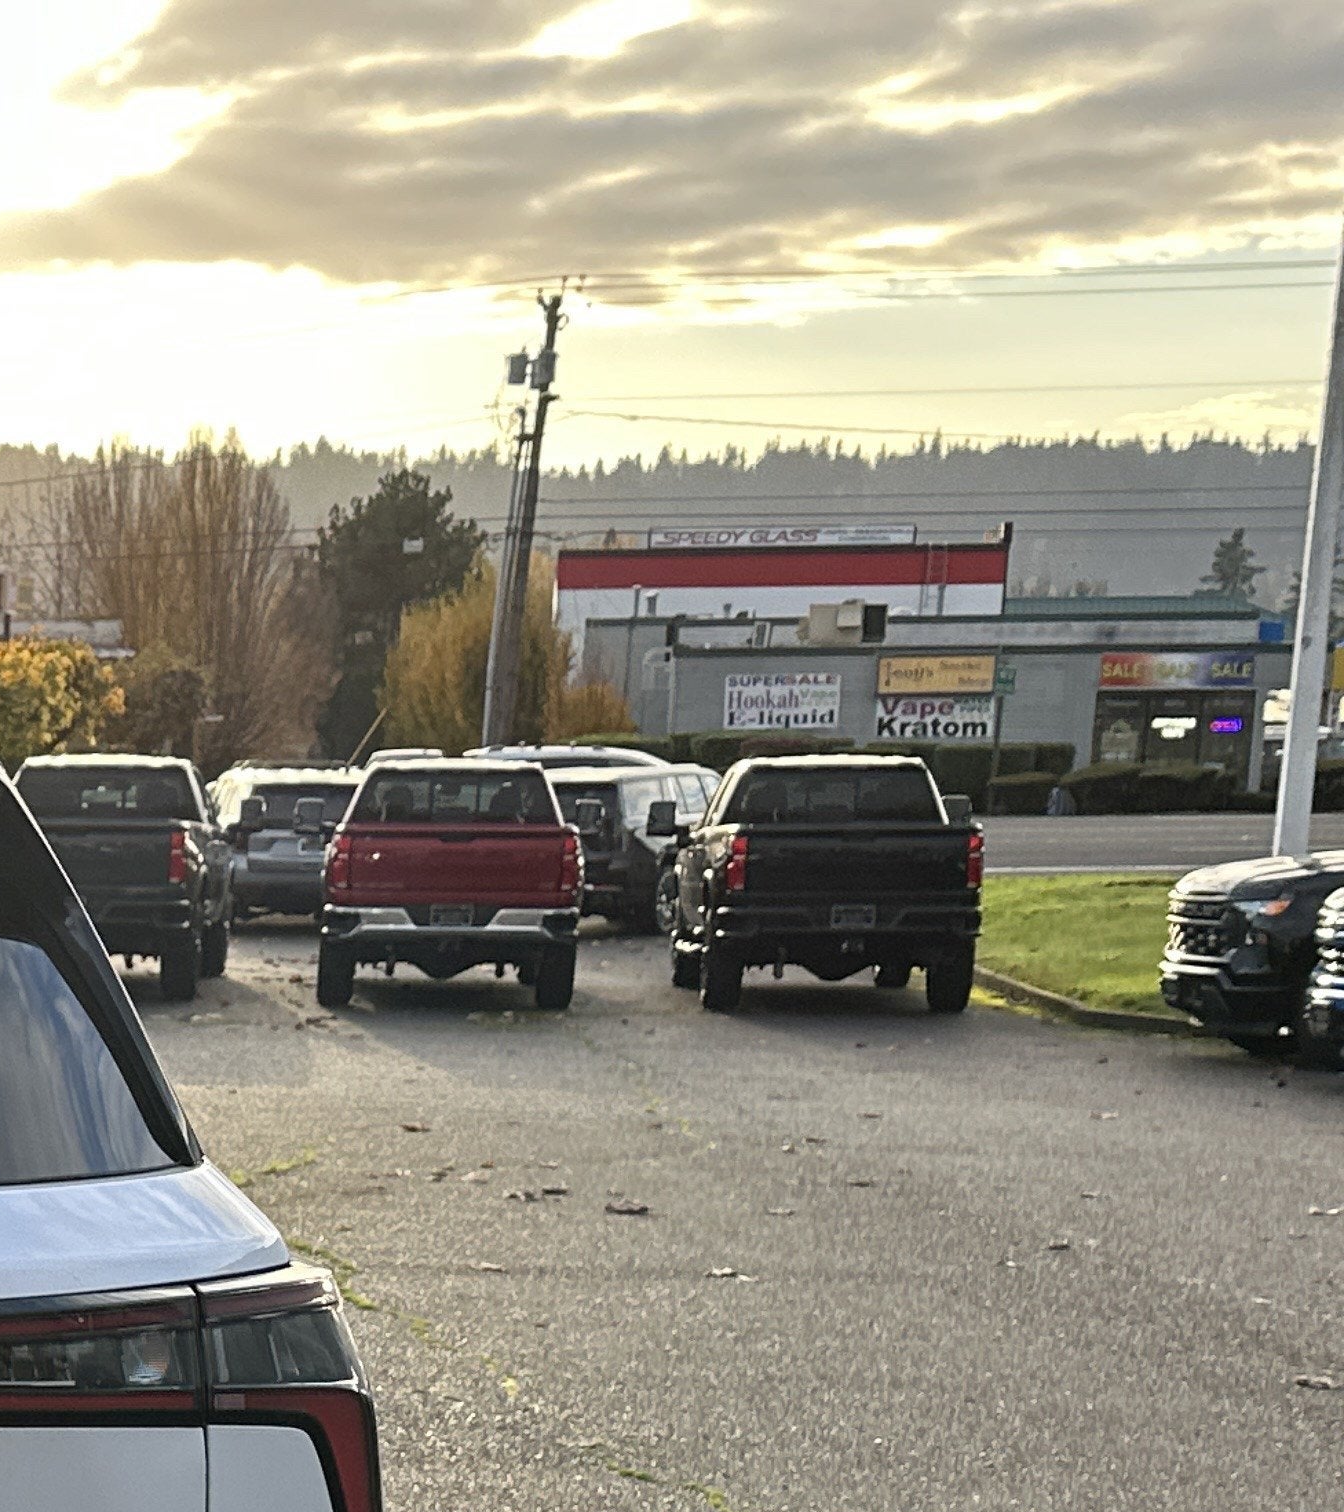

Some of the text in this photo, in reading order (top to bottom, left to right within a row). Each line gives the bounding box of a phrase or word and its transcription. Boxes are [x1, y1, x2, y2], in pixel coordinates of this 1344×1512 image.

[655, 530, 746, 545] SPEEDY
[749, 528, 820, 543] GLASS
[1102, 661, 1142, 679] SALE
[1212, 660, 1253, 679] SALE
[728, 689, 800, 709] Hookah
[879, 697, 954, 719] Vape
[728, 707, 834, 729] E-liquid
[876, 716, 988, 737] Kratom
